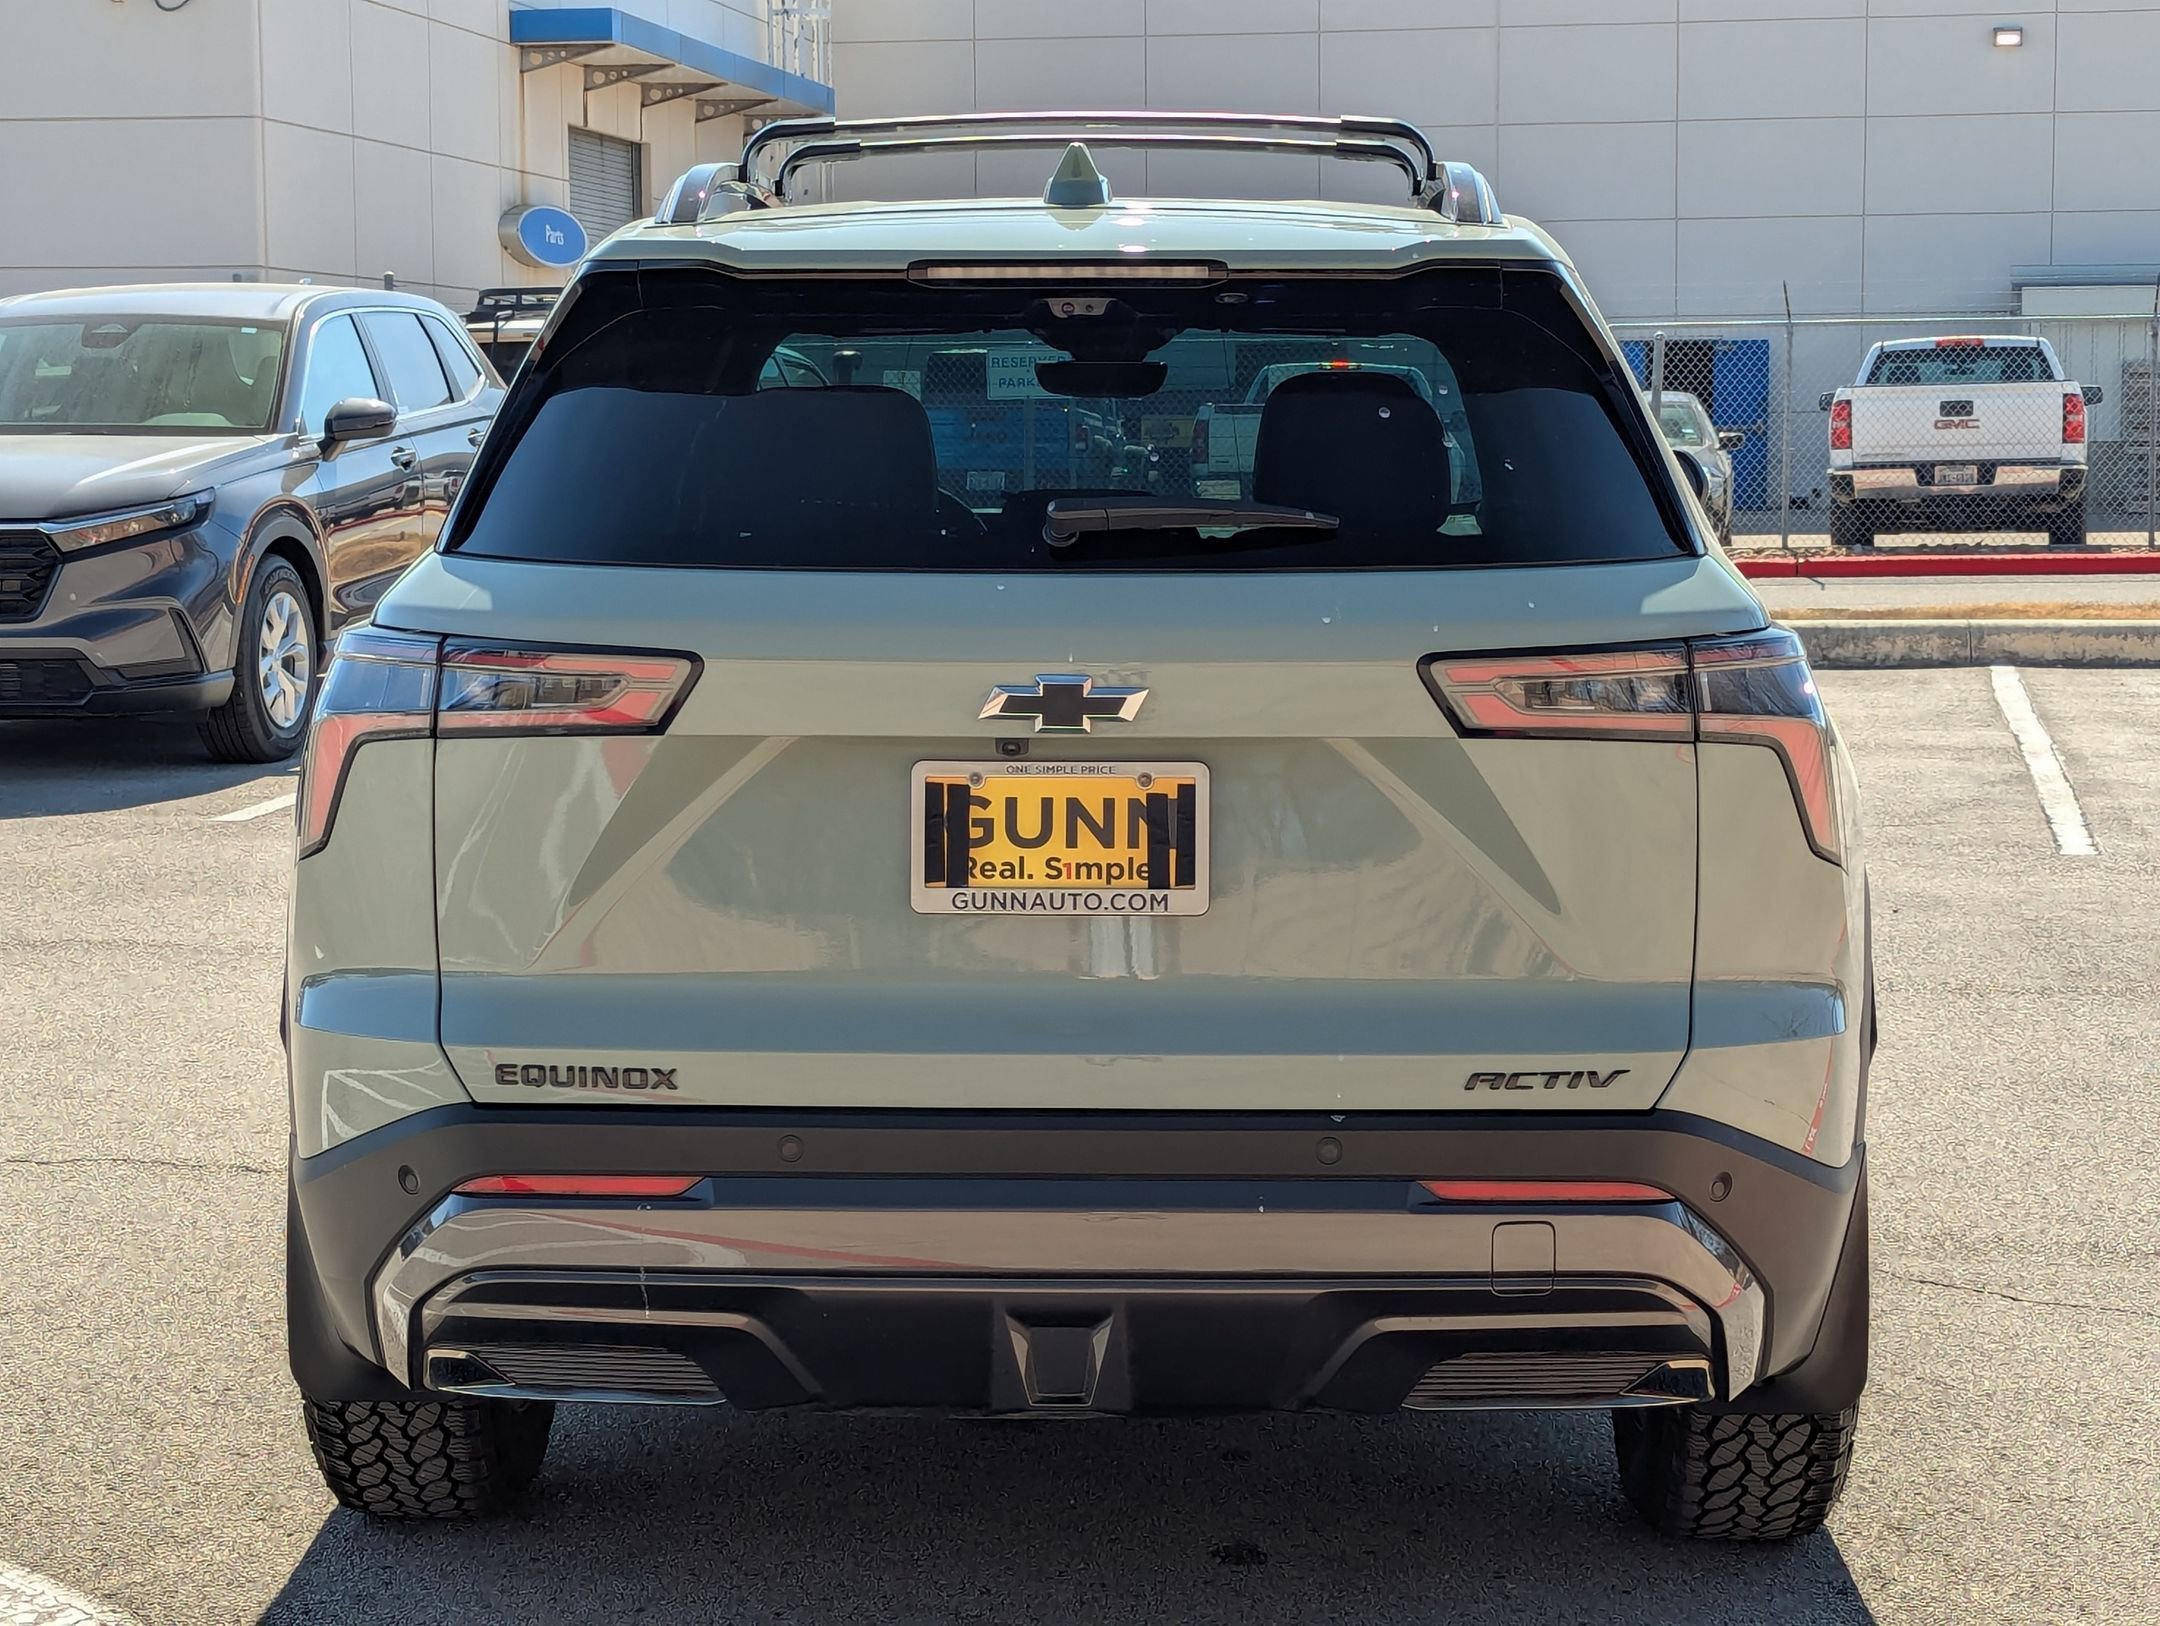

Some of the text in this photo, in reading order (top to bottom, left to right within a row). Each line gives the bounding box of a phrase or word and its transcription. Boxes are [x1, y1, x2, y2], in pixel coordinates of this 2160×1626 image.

[545, 224, 565, 246] Parts
[998, 377, 1040, 389] PARK
[1934, 419, 1980, 430] GMC
[1006, 765, 1116, 775] ONE SIMPLE PRICE
[945, 795, 1178, 849] GUNN
[951, 892, 1169, 912] GUNNAUTO.COM
[495, 1063, 679, 1090] EQUINOX
[1463, 1069, 1632, 1091] ACTIV
